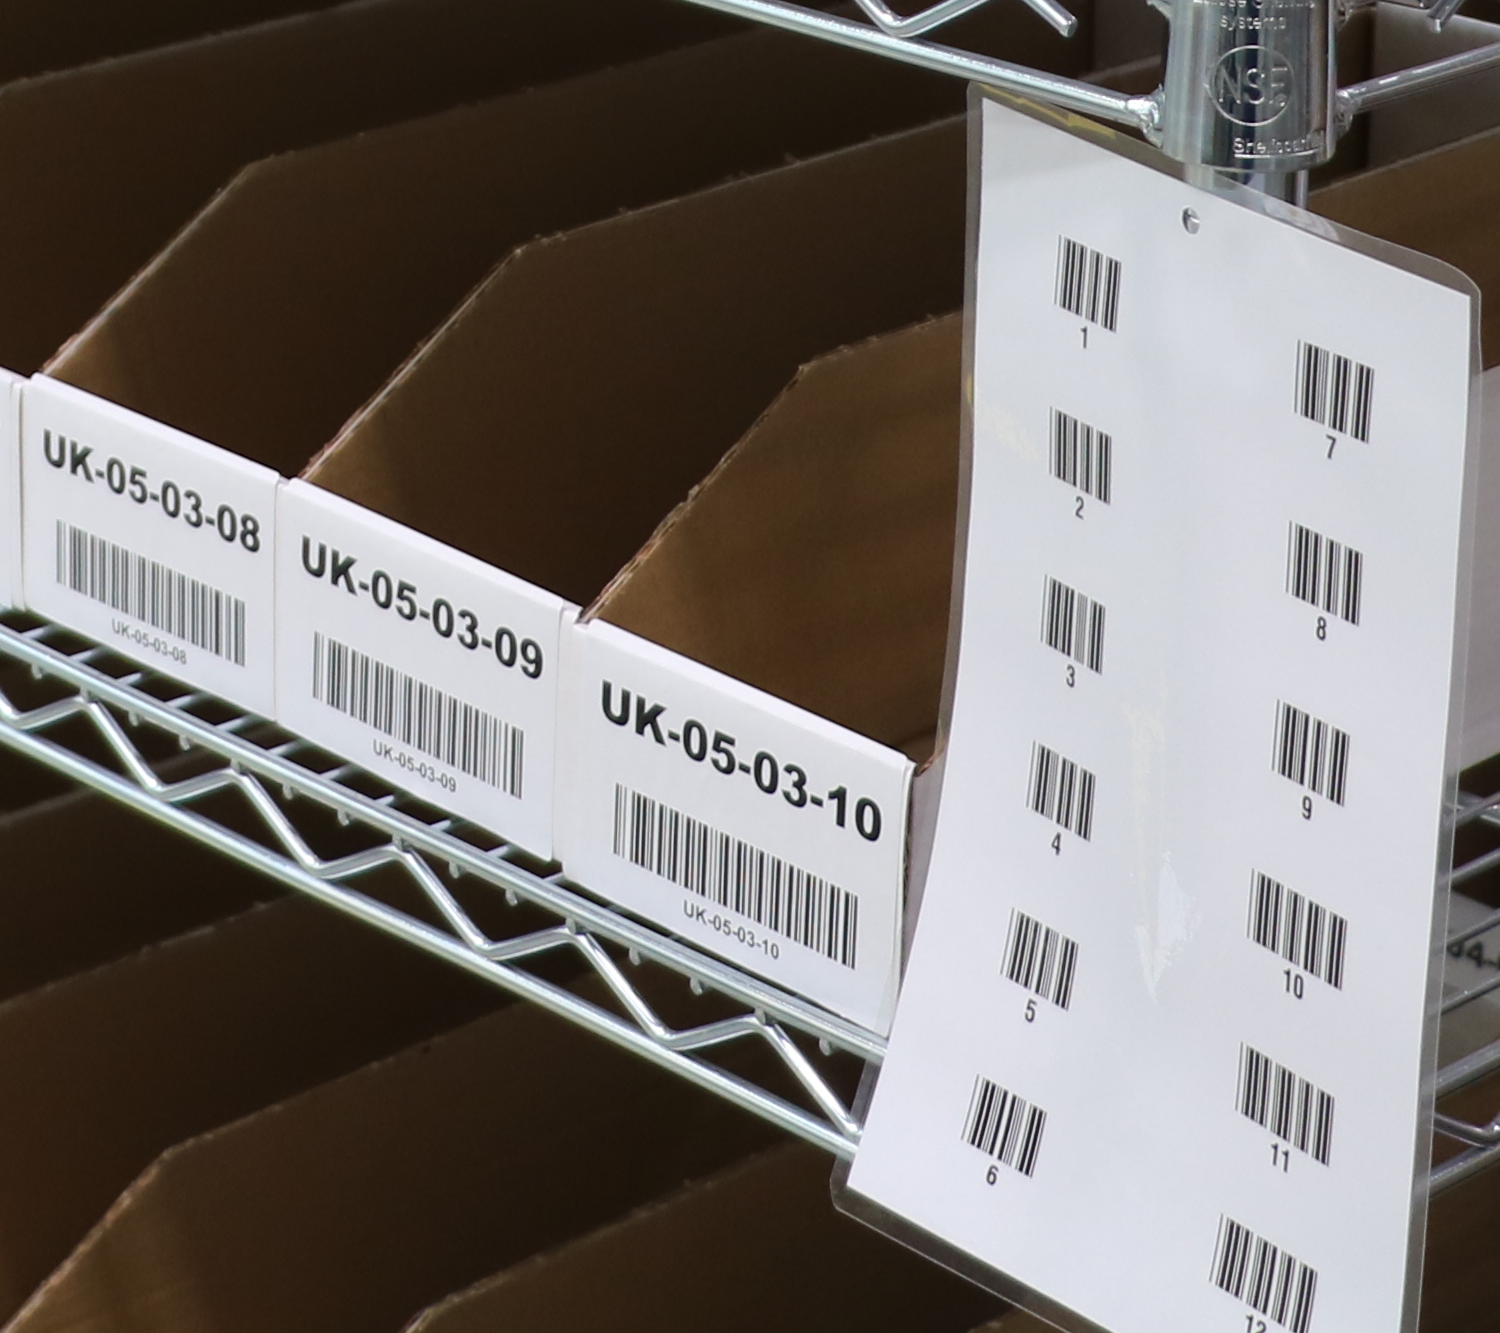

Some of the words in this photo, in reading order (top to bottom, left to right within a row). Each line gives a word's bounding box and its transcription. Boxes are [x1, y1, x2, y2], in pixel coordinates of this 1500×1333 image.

[1080, 325, 1088, 349] 1
[1326, 434, 1337, 460] 7
[43, 430, 261, 554] UK-05-03-08
[1075, 495, 1085, 520] 2
[301, 536, 544, 680] UK-05-03-09
[111, 618, 187, 666] UK-05-03-08
[1315, 616, 1327, 642] 8
[1065, 664, 1076, 689] 3
[373, 739, 457, 793] UK-05-03-09
[601, 680, 882, 842] UK-05-03-10
[1302, 795, 1313, 821] 9
[1051, 832, 1062, 856] 4
[683, 901, 781, 961] UK-05-03-10
[1283, 968, 1305, 1000] 10
[1024, 998, 1037, 1024] 5
[1270, 1142, 1291, 1173] 11
[985, 1164, 999, 1186] 6
